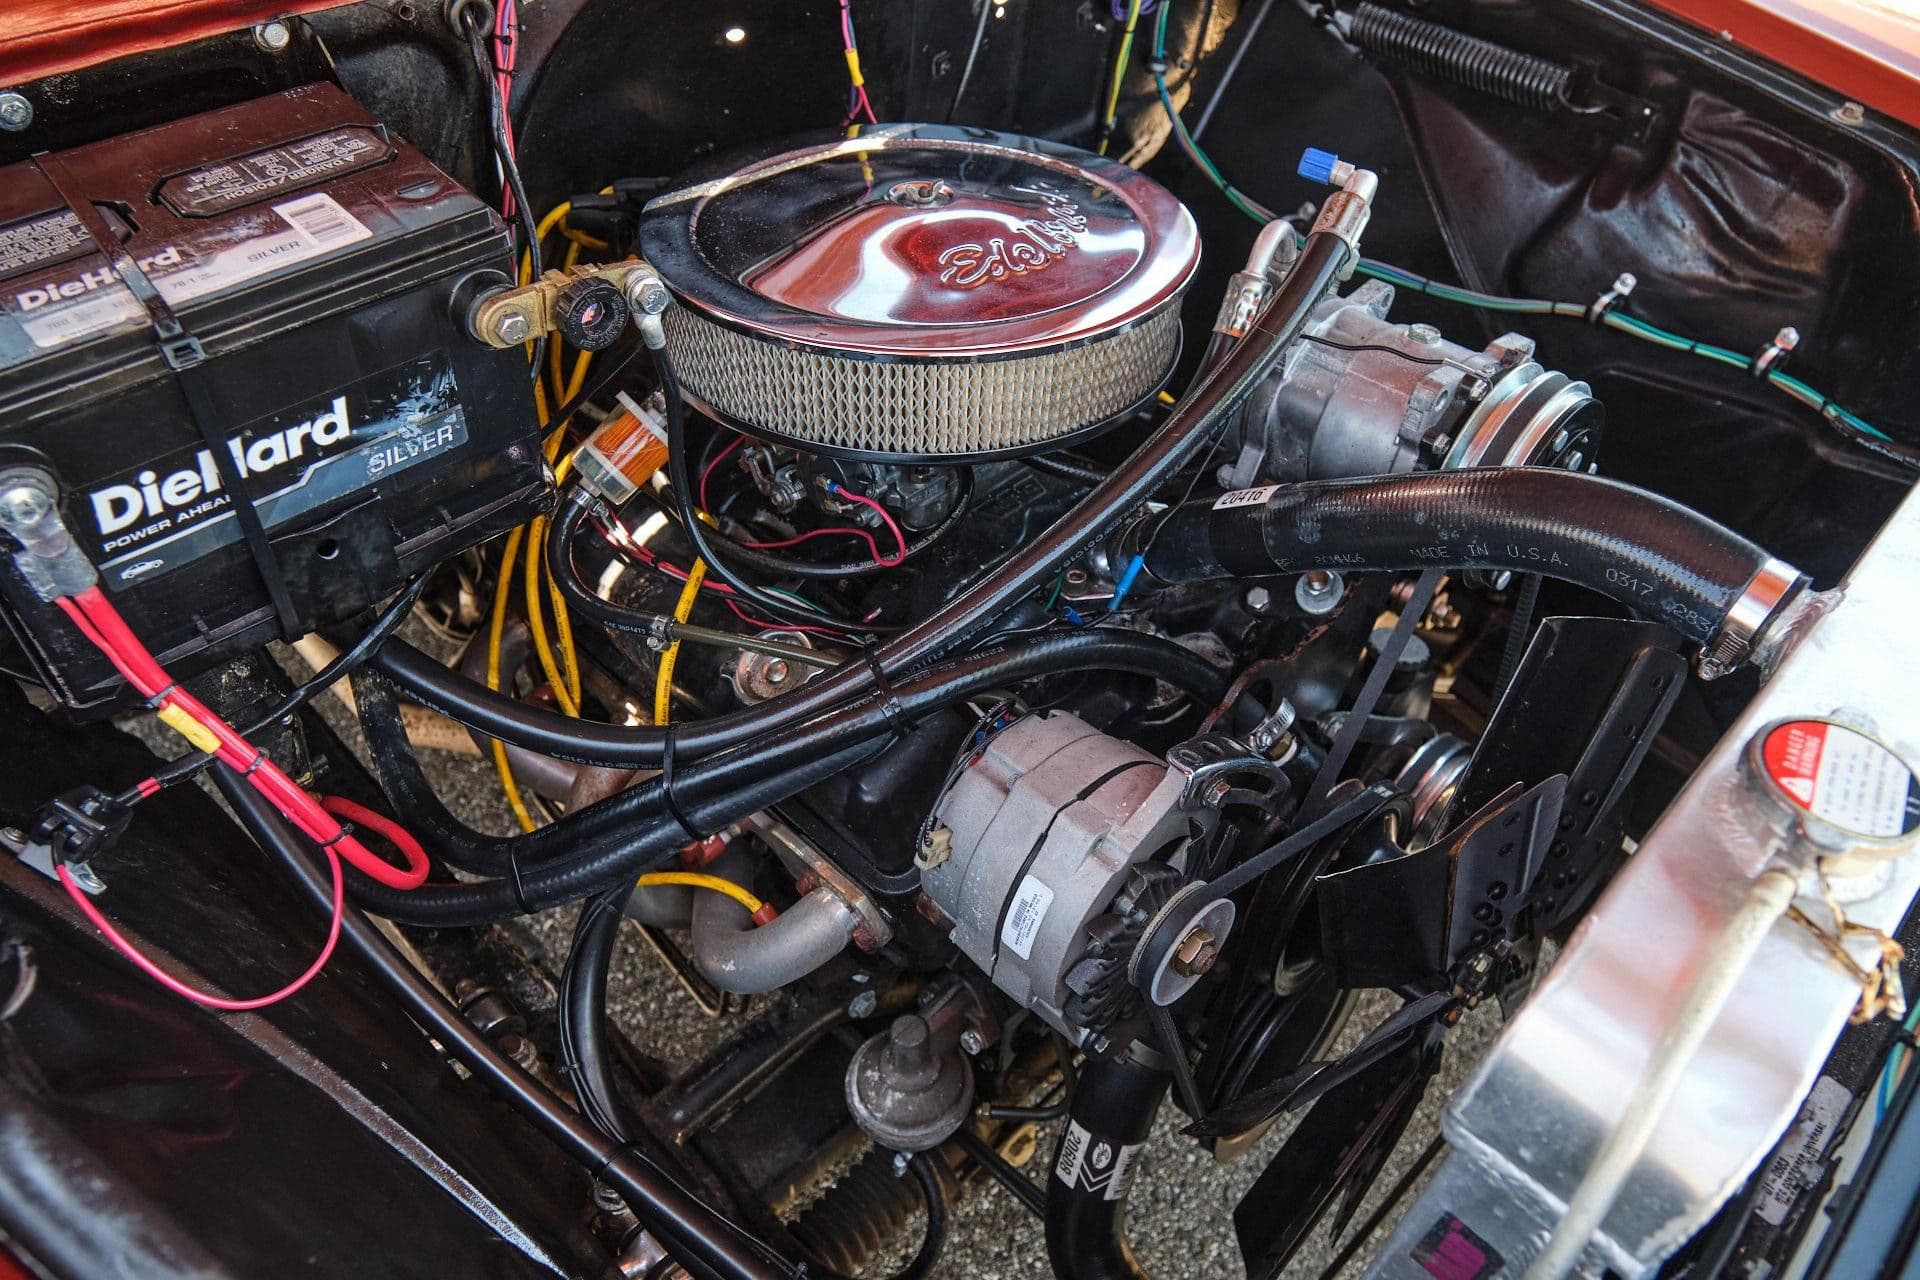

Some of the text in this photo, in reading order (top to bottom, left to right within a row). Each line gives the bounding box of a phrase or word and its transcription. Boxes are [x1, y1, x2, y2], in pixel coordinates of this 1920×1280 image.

[224, 179, 277, 201] POISON
[248, 240, 301, 263] SILVER
[16, 246, 183, 312] DieHrd
[369, 425, 454, 474] SILVER
[1221, 487, 1267, 505] 20416
[103, 519, 172, 553] POWER
[1410, 544, 1569, 567] MADE IN U.S.A.
[1060, 1129, 1082, 1176] 20608
